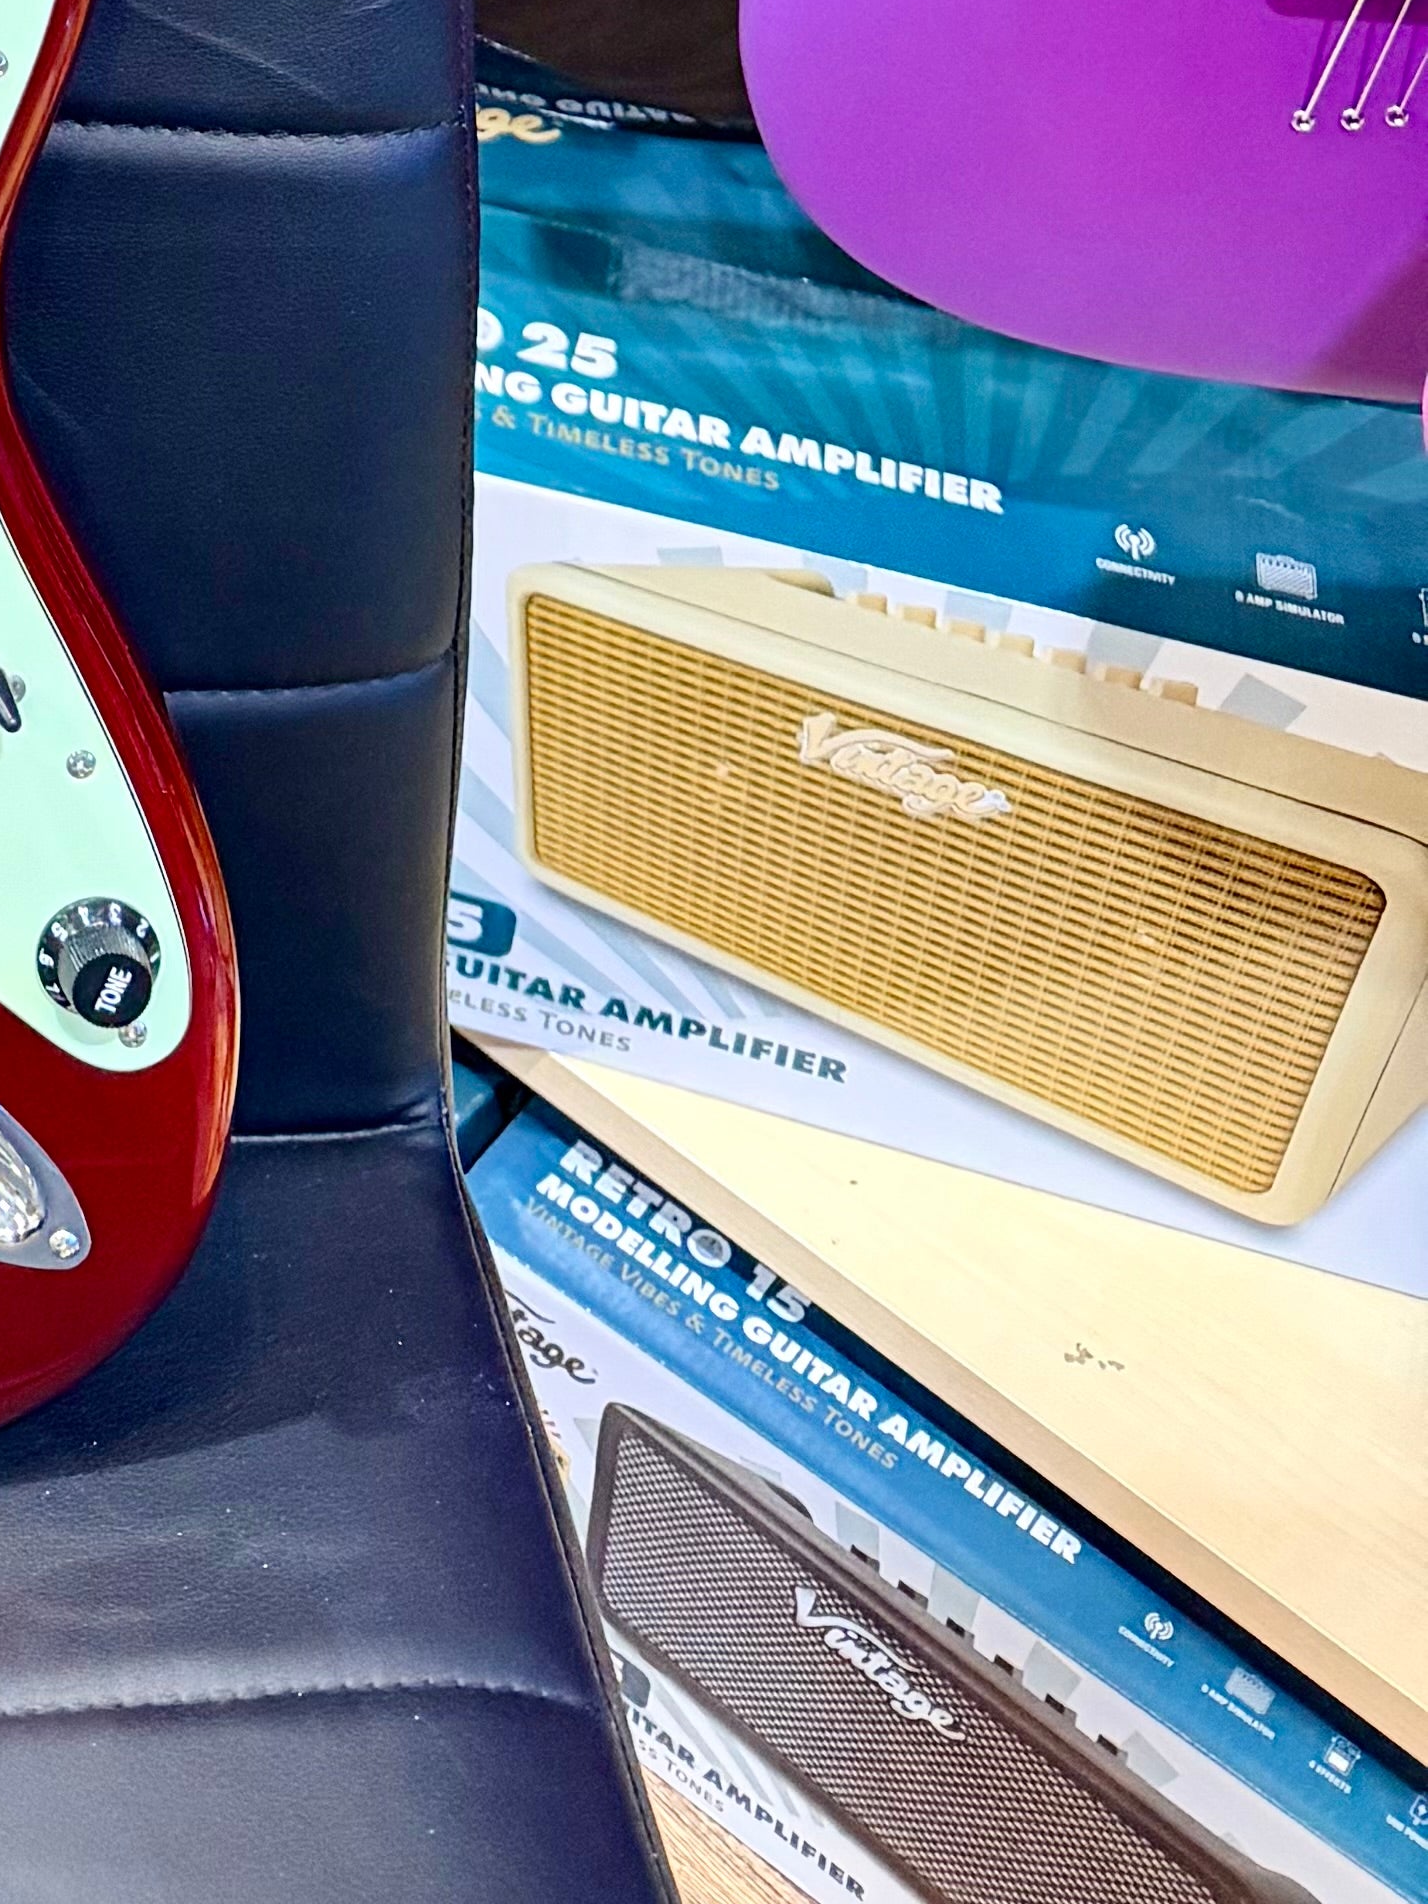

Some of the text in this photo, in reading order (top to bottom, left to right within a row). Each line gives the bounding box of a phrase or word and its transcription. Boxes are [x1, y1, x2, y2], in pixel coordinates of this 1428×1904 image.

[516, 321, 618, 380] 25
[491, 406, 781, 491] & TIMELESS TONES
[550, 383, 1005, 515] GUITAR AMPLIFIER
[1096, 557, 1176, 585] CONNECTIVITY
[1245, 593, 1344, 625] AMP SIMULATOR
[800, 712, 1001, 817] Vintage
[94, 966, 132, 1014] TONE
[539, 1010, 632, 1053] TONES
[599, 997, 848, 1084] AMPLIFIER
[559, 1139, 812, 1324] RETRO 15
[525, 1196, 899, 1471] VINTAGE VIBES & TIMELESS TONES
[535, 1173, 1083, 1566] MODELLING GUITAR AMPLIFIER
[795, 1586, 966, 1742] Vintage
[665, 1757, 725, 1813] TONES
[703, 1768, 865, 1902] AMPLIFIER
